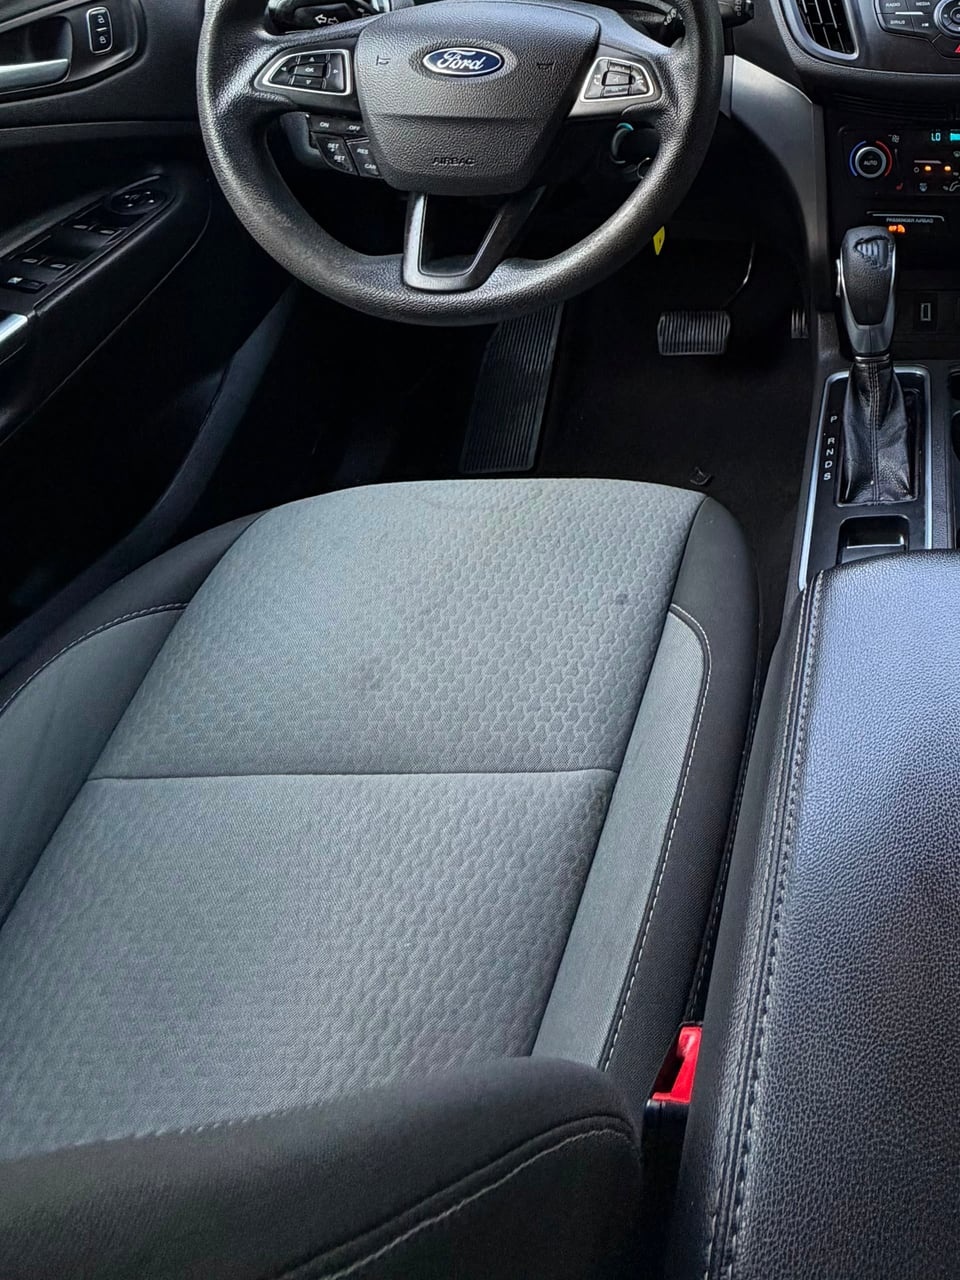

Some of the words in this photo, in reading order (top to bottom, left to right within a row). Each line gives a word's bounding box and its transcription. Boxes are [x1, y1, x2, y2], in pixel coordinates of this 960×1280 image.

[437, 50, 486, 70] Ford
[931, 132, 941, 141] LO
[432, 156, 475, 166] AIRBAG
[827, 437, 835, 445] R
[826, 448, 834, 456] N
[823, 472, 831, 480] S
